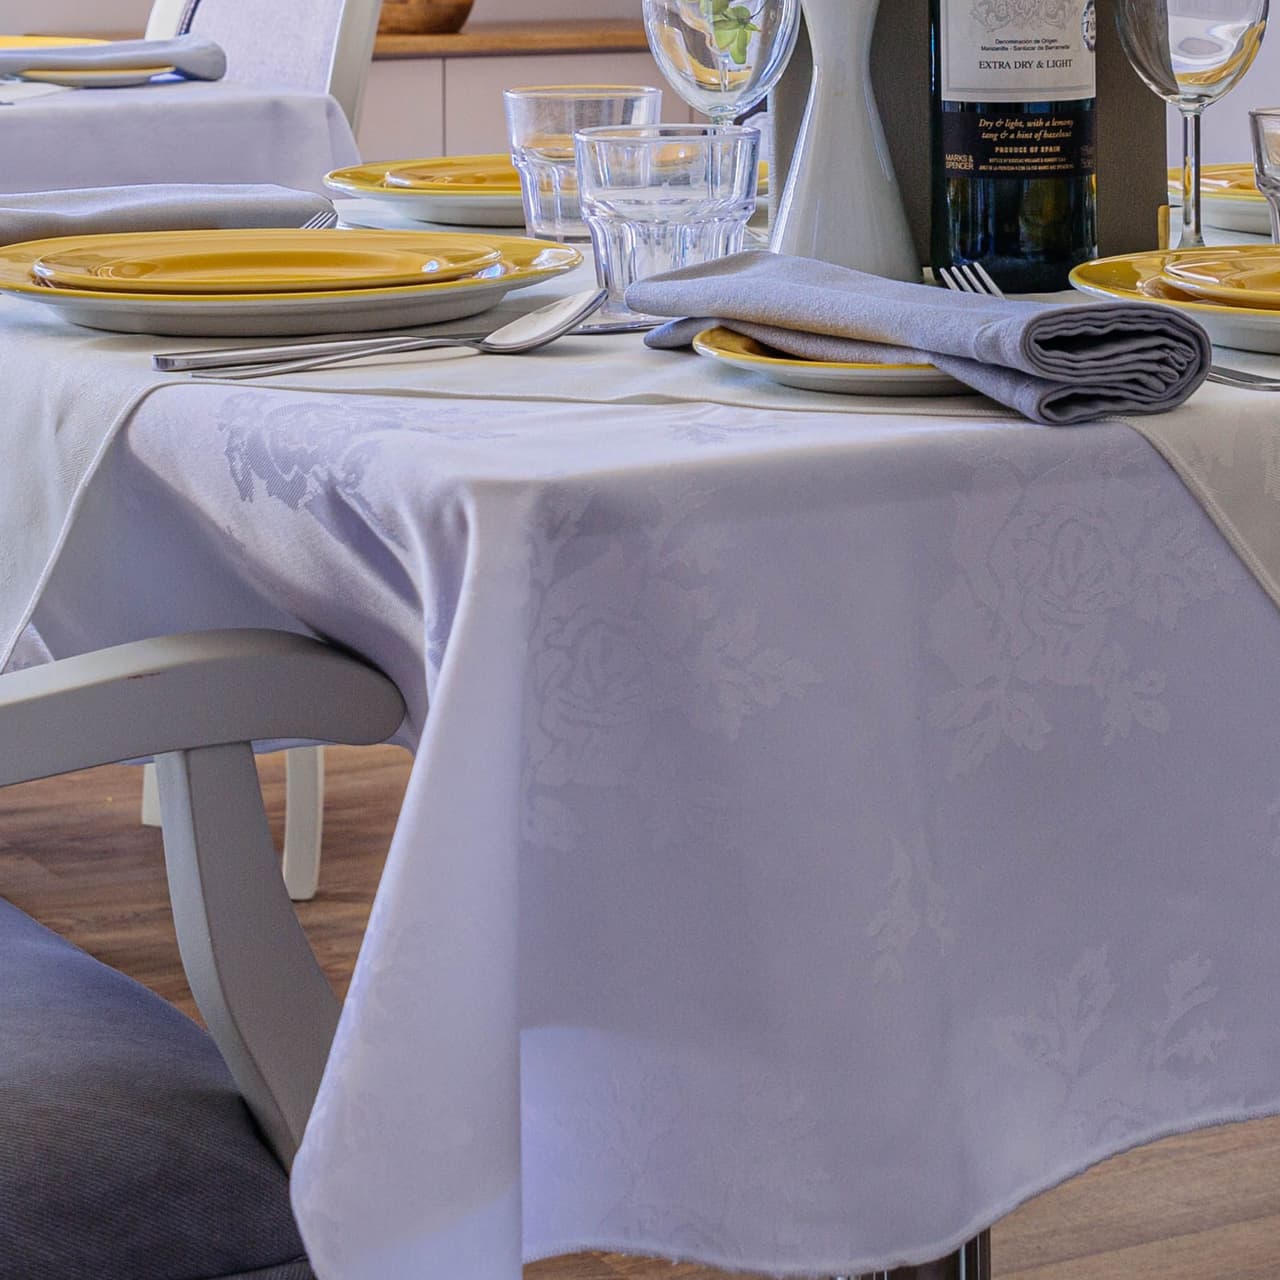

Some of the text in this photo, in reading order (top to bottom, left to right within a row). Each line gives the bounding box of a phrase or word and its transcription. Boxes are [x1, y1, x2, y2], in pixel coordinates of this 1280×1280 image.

[979, 59, 1072, 69] EXTRA DRY & LIGHT
[979, 119, 993, 129] Dry
[995, 118, 1004, 127] &
[1026, 118, 1043, 127] with
[1000, 130, 1008, 139] &
[1016, 130, 1032, 139] hint
[1034, 129, 1043, 141] of
[945, 153, 968, 161] MARKS
[945, 161, 974, 170] SPENCER
